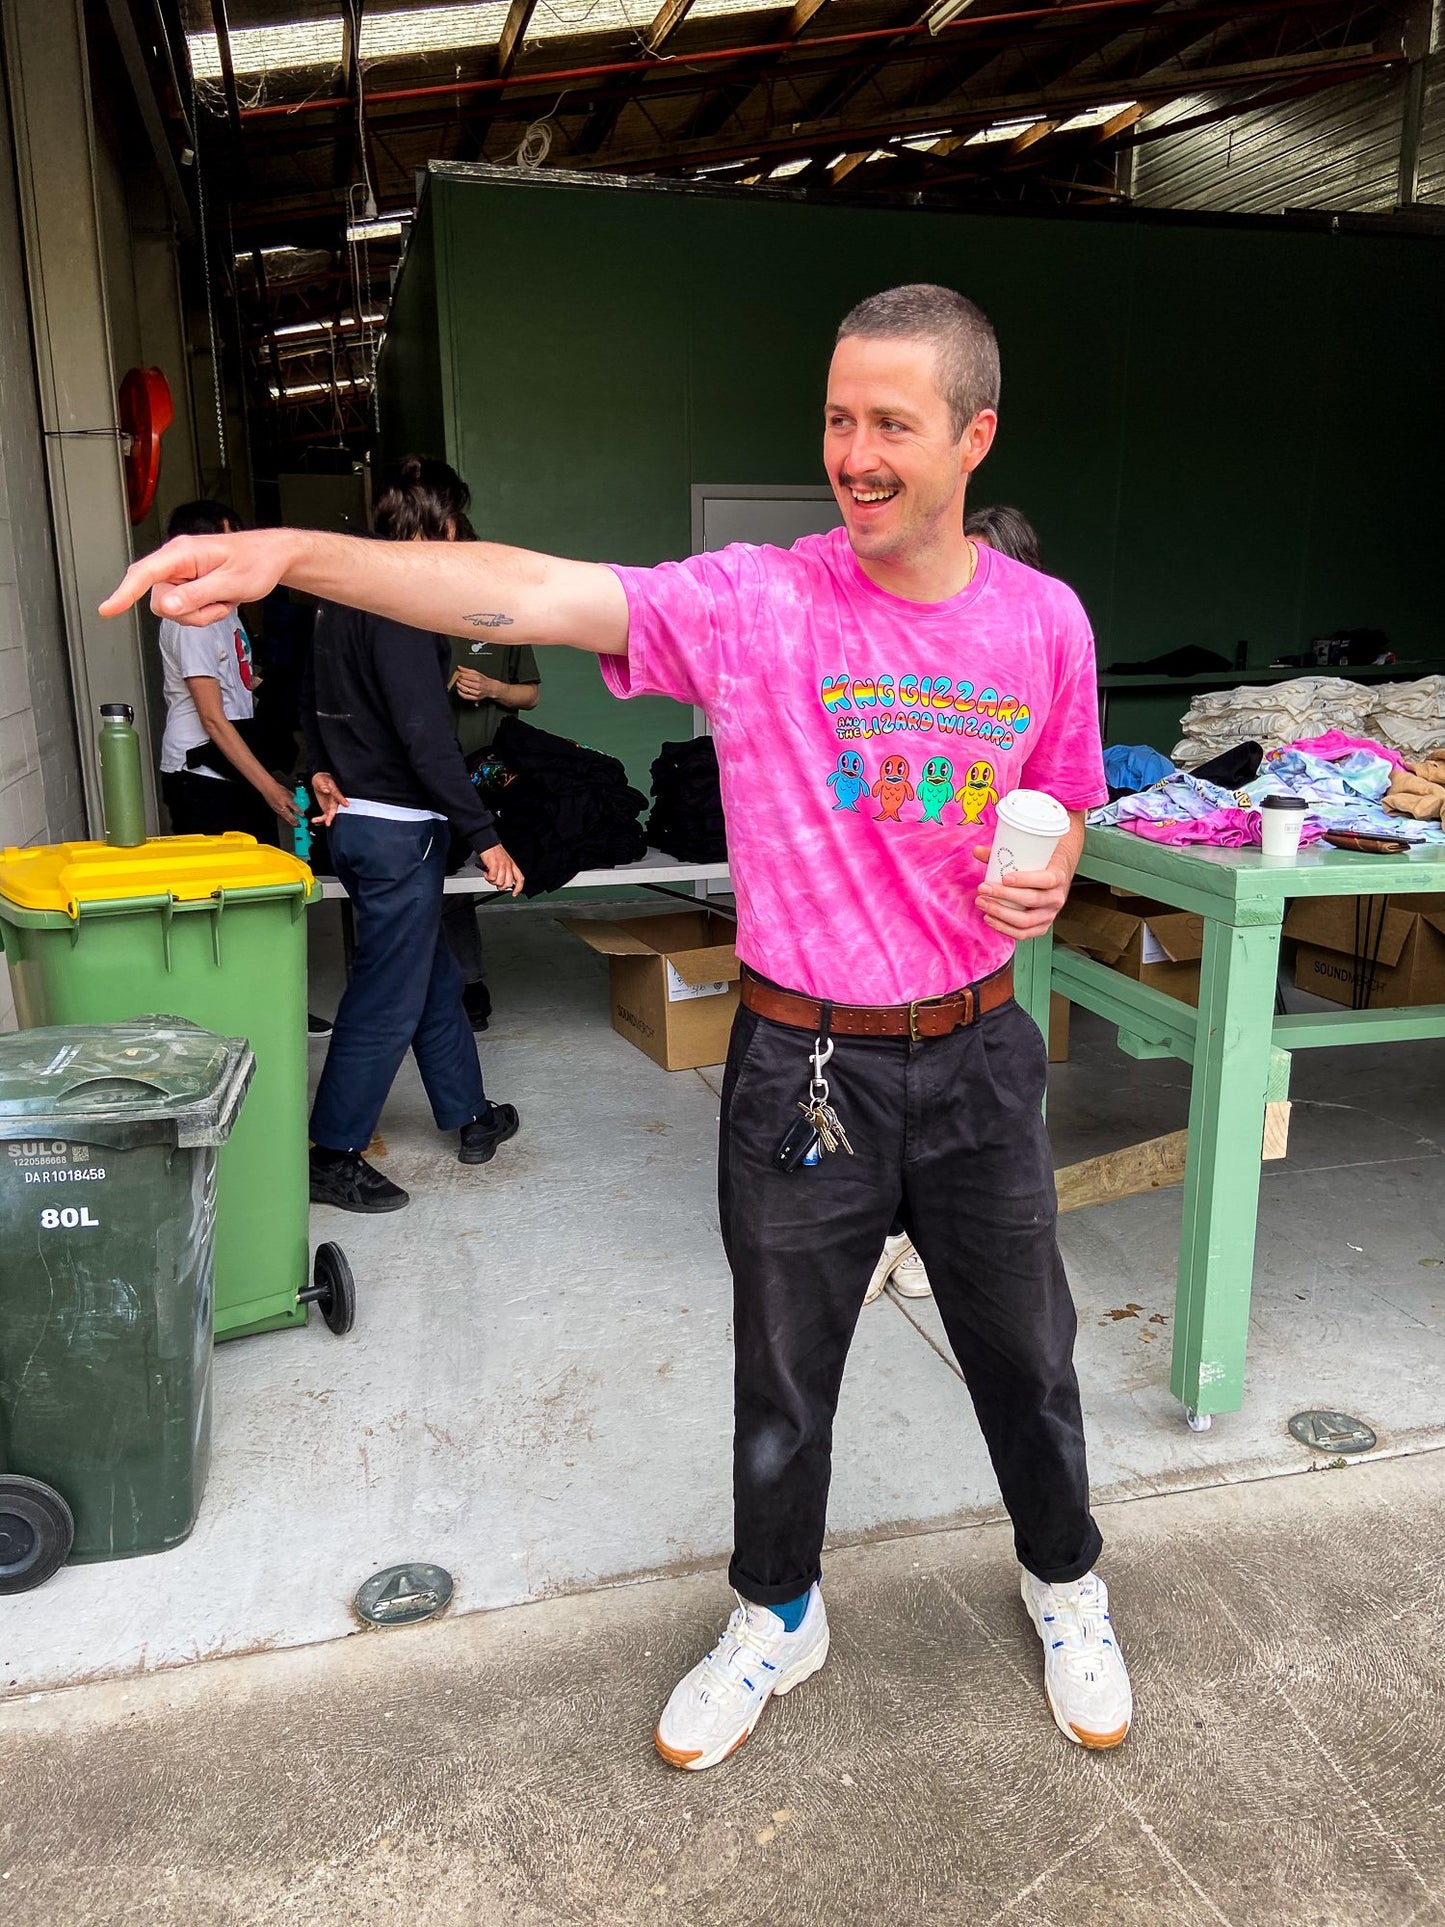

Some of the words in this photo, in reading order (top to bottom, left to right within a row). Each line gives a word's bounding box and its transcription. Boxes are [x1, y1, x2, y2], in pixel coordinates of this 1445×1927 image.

[821, 674, 895, 714] KNG
[899, 674, 1031, 734] GIZZARD
[837, 716, 860, 728] AND
[861, 711, 934, 739] LIZARD
[937, 712, 1014, 750] WIZARD
[836, 727, 861, 740] THE
[8, 1141, 67, 1157] SULO
[41, 1206, 99, 1229] 80L
